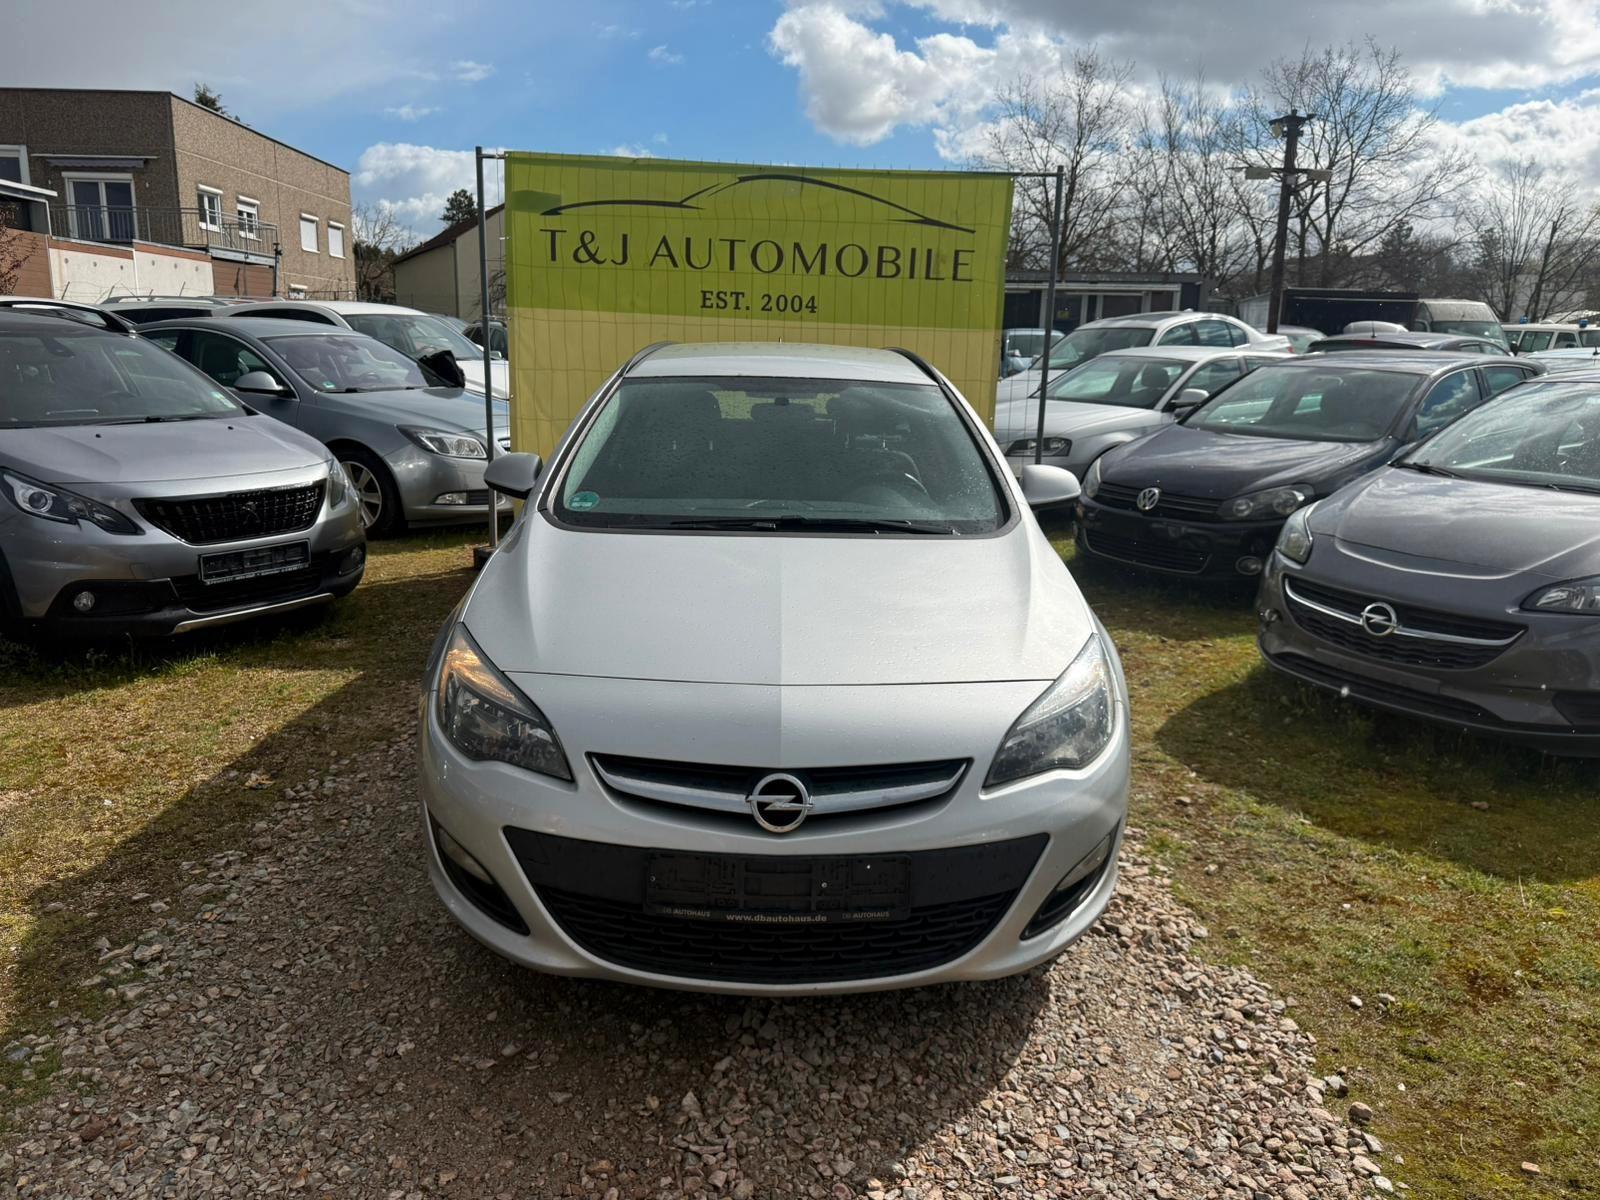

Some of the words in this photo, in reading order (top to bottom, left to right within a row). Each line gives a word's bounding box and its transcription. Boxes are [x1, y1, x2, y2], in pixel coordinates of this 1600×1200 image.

[540, 229, 629, 266] T&J
[649, 235, 976, 282] AUTOMOBILE
[700, 290, 750, 310] EST.
[760, 294, 818, 314] 2004
[673, 907, 711, 918] AUTOHAUS
[725, 912, 827, 923] www.dbautohaus.de
[853, 910, 890, 919] AUTOHAUS
